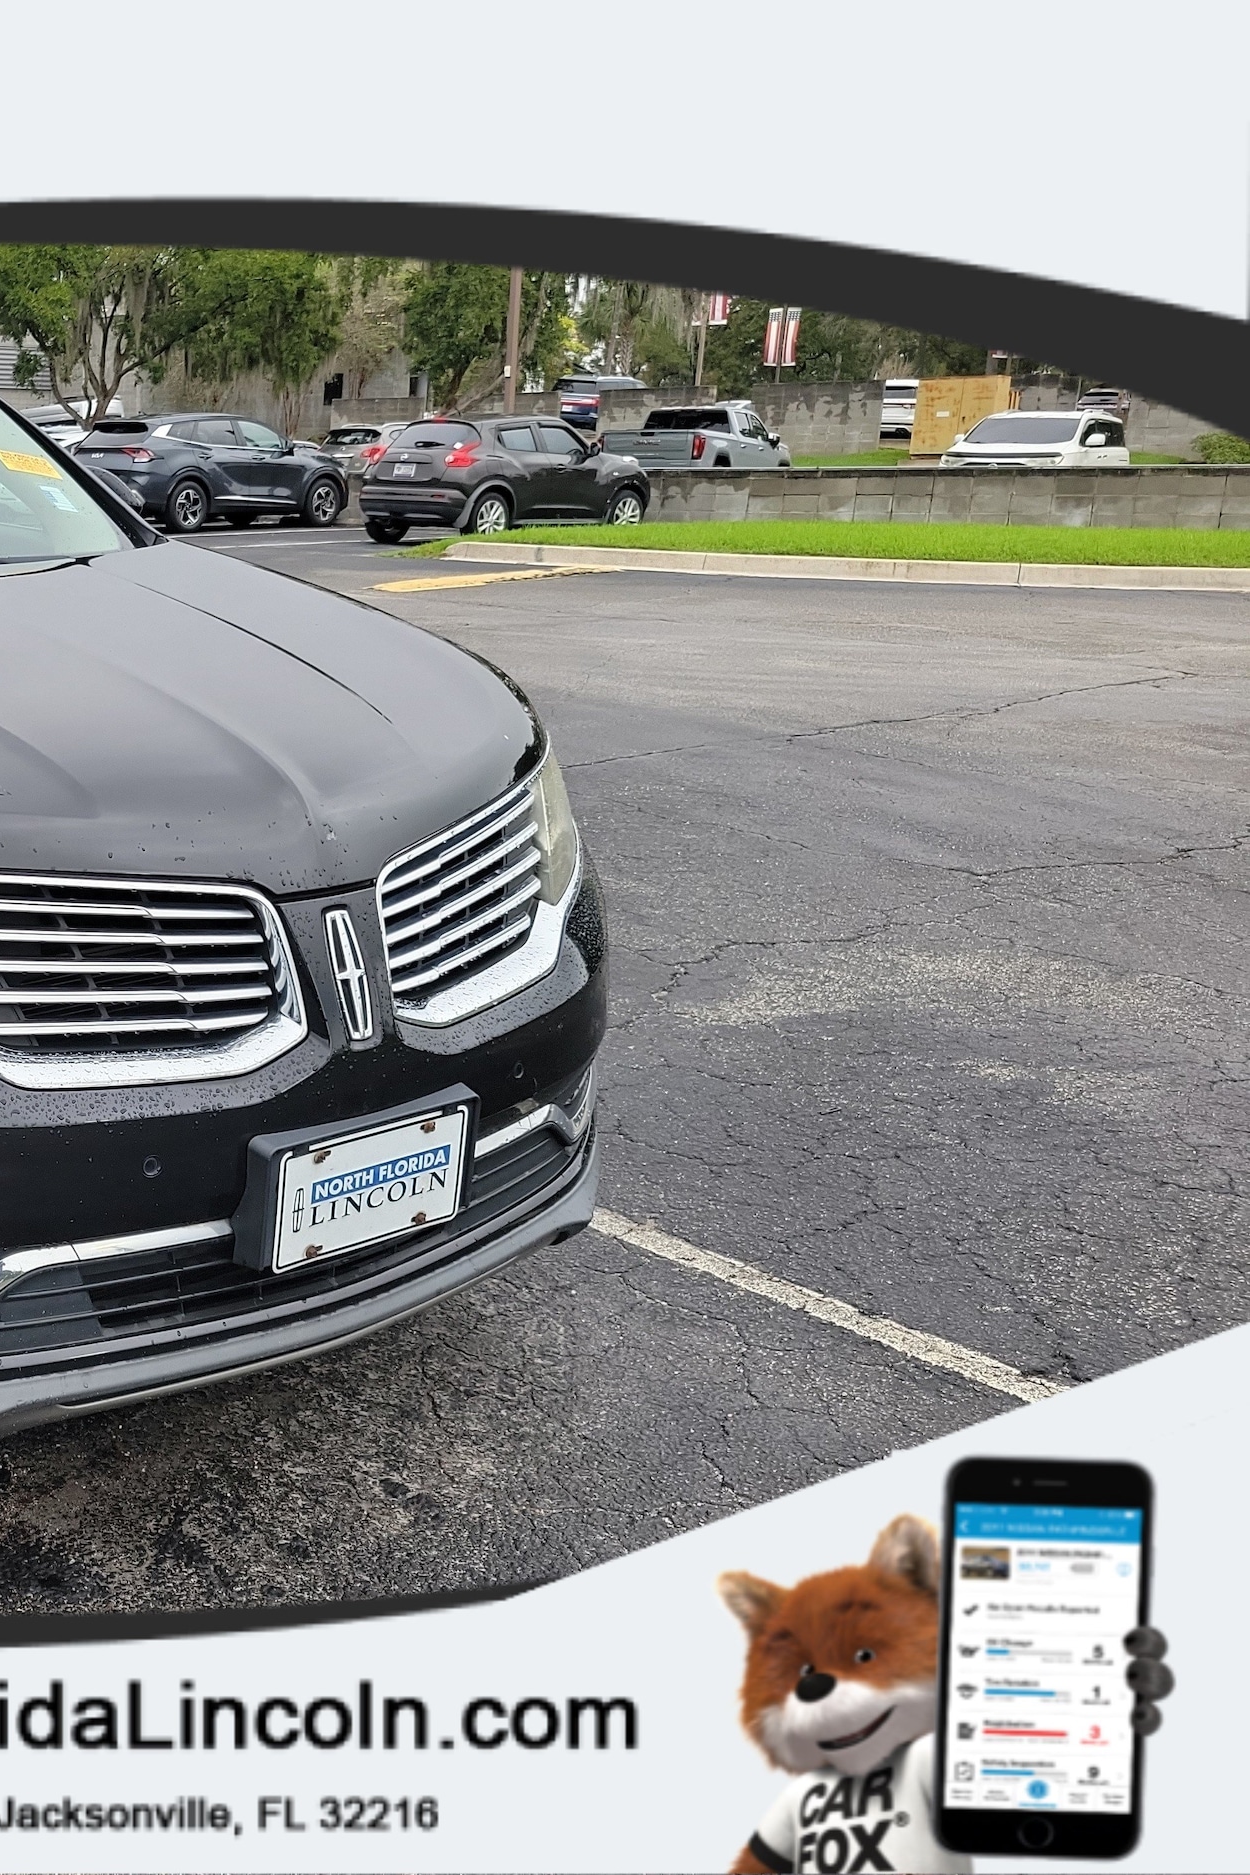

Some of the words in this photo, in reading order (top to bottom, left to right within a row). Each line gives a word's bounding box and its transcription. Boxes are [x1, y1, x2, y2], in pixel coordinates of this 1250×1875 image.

[308, 1167, 450, 1228] LINCOLN
[314, 1168, 375, 1201] NORTH
[378, 1148, 448, 1182] FLORIDA
